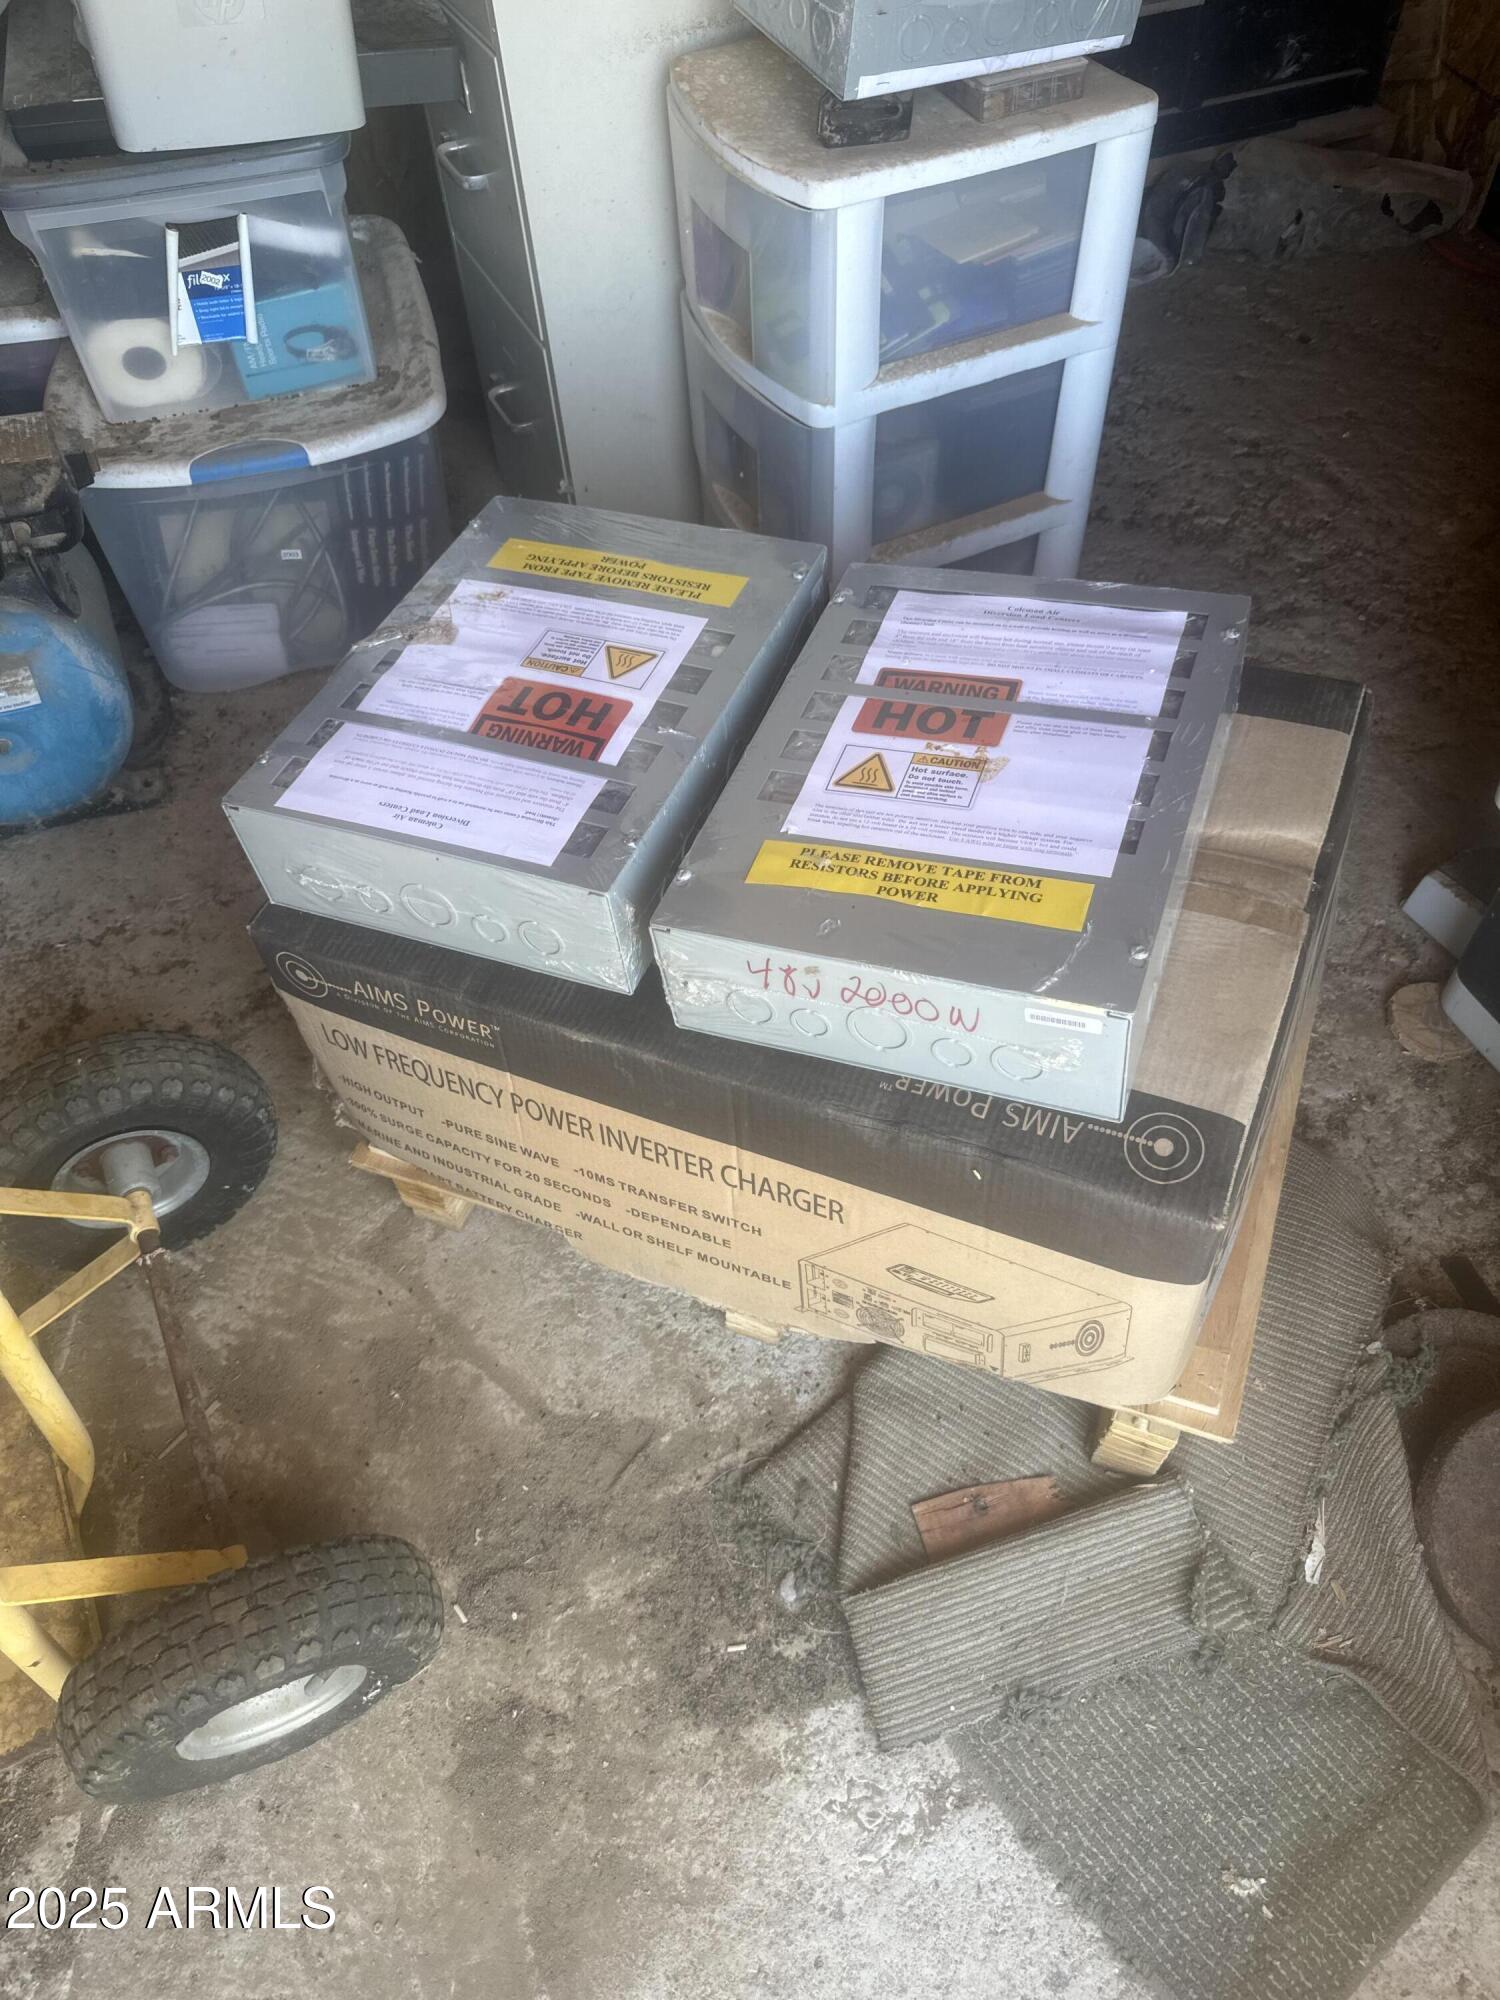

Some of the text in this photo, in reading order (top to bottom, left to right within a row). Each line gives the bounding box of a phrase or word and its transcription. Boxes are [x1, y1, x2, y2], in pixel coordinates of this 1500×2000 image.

[188, 273, 230, 288] filx
[201, 274, 222, 287] 2002
[523, 552, 712, 590] RESISTORS BEFORE APPLYING
[598, 555, 648, 569] POWER
[520, 562, 703, 599] PLEASE REMOVE TAPE FROM
[524, 659, 570, 672] CAUTION
[891, 677, 1000, 699] WARNING
[493, 683, 617, 731] HOT
[870, 700, 996, 739] HOT
[481, 722, 589, 756] WARNING
[929, 756, 980, 769] CAUTION
[930, 767, 969, 778] surface.
[937, 777, 964, 785] touch.
[375, 800, 471, 826] Diversion Load Centers
[390, 812, 445, 830] Coleman Air
[788, 858, 1044, 903] RESISTORS BEFORE APPLYING
[798, 846, 1042, 889] PLEASE REMOVE TAPE FROM
[876, 884, 940, 903] POWER
[354, 980, 408, 1011] AIMS
[438, 1025, 496, 1048] CORPORATION
[320, 1023, 845, 1224] LOW FREQUENCY POWER INVERTER CHARGER
[1002, 1101, 1084, 1144] AIMS
[374, 1090, 424, 1118] OUTPUT
[441, 1118, 484, 1143] -PURE
[485, 1132, 518, 1154] SINE
[519, 1145, 560, 1168] WAVE
[573, 1167, 616, 1188] -10MS
[619, 1180, 698, 1216] TRANSFER
[702, 1209, 762, 1238] SWITCH
[380, 1112, 424, 1138] SURGE
[426, 1132, 492, 1164] CAPACITY
[494, 1158, 522, 1177] FOR
[525, 1170, 540, 1183] 20
[544, 1176, 612, 1208] SECONDS
[626, 1206, 732, 1250] -DEPENDABLE
[404, 1144, 430, 1160] AND
[433, 1154, 512, 1194] INDUSTRIAL
[514, 1187, 562, 1213] GRADE
[576, 1210, 620, 1234] -WALL
[622, 1224, 644, 1242] OR
[646, 1234, 694, 1258] SHELF
[697, 1251, 792, 1292] MOUNTABLE
[515, 1209, 584, 1241] CHARGER
